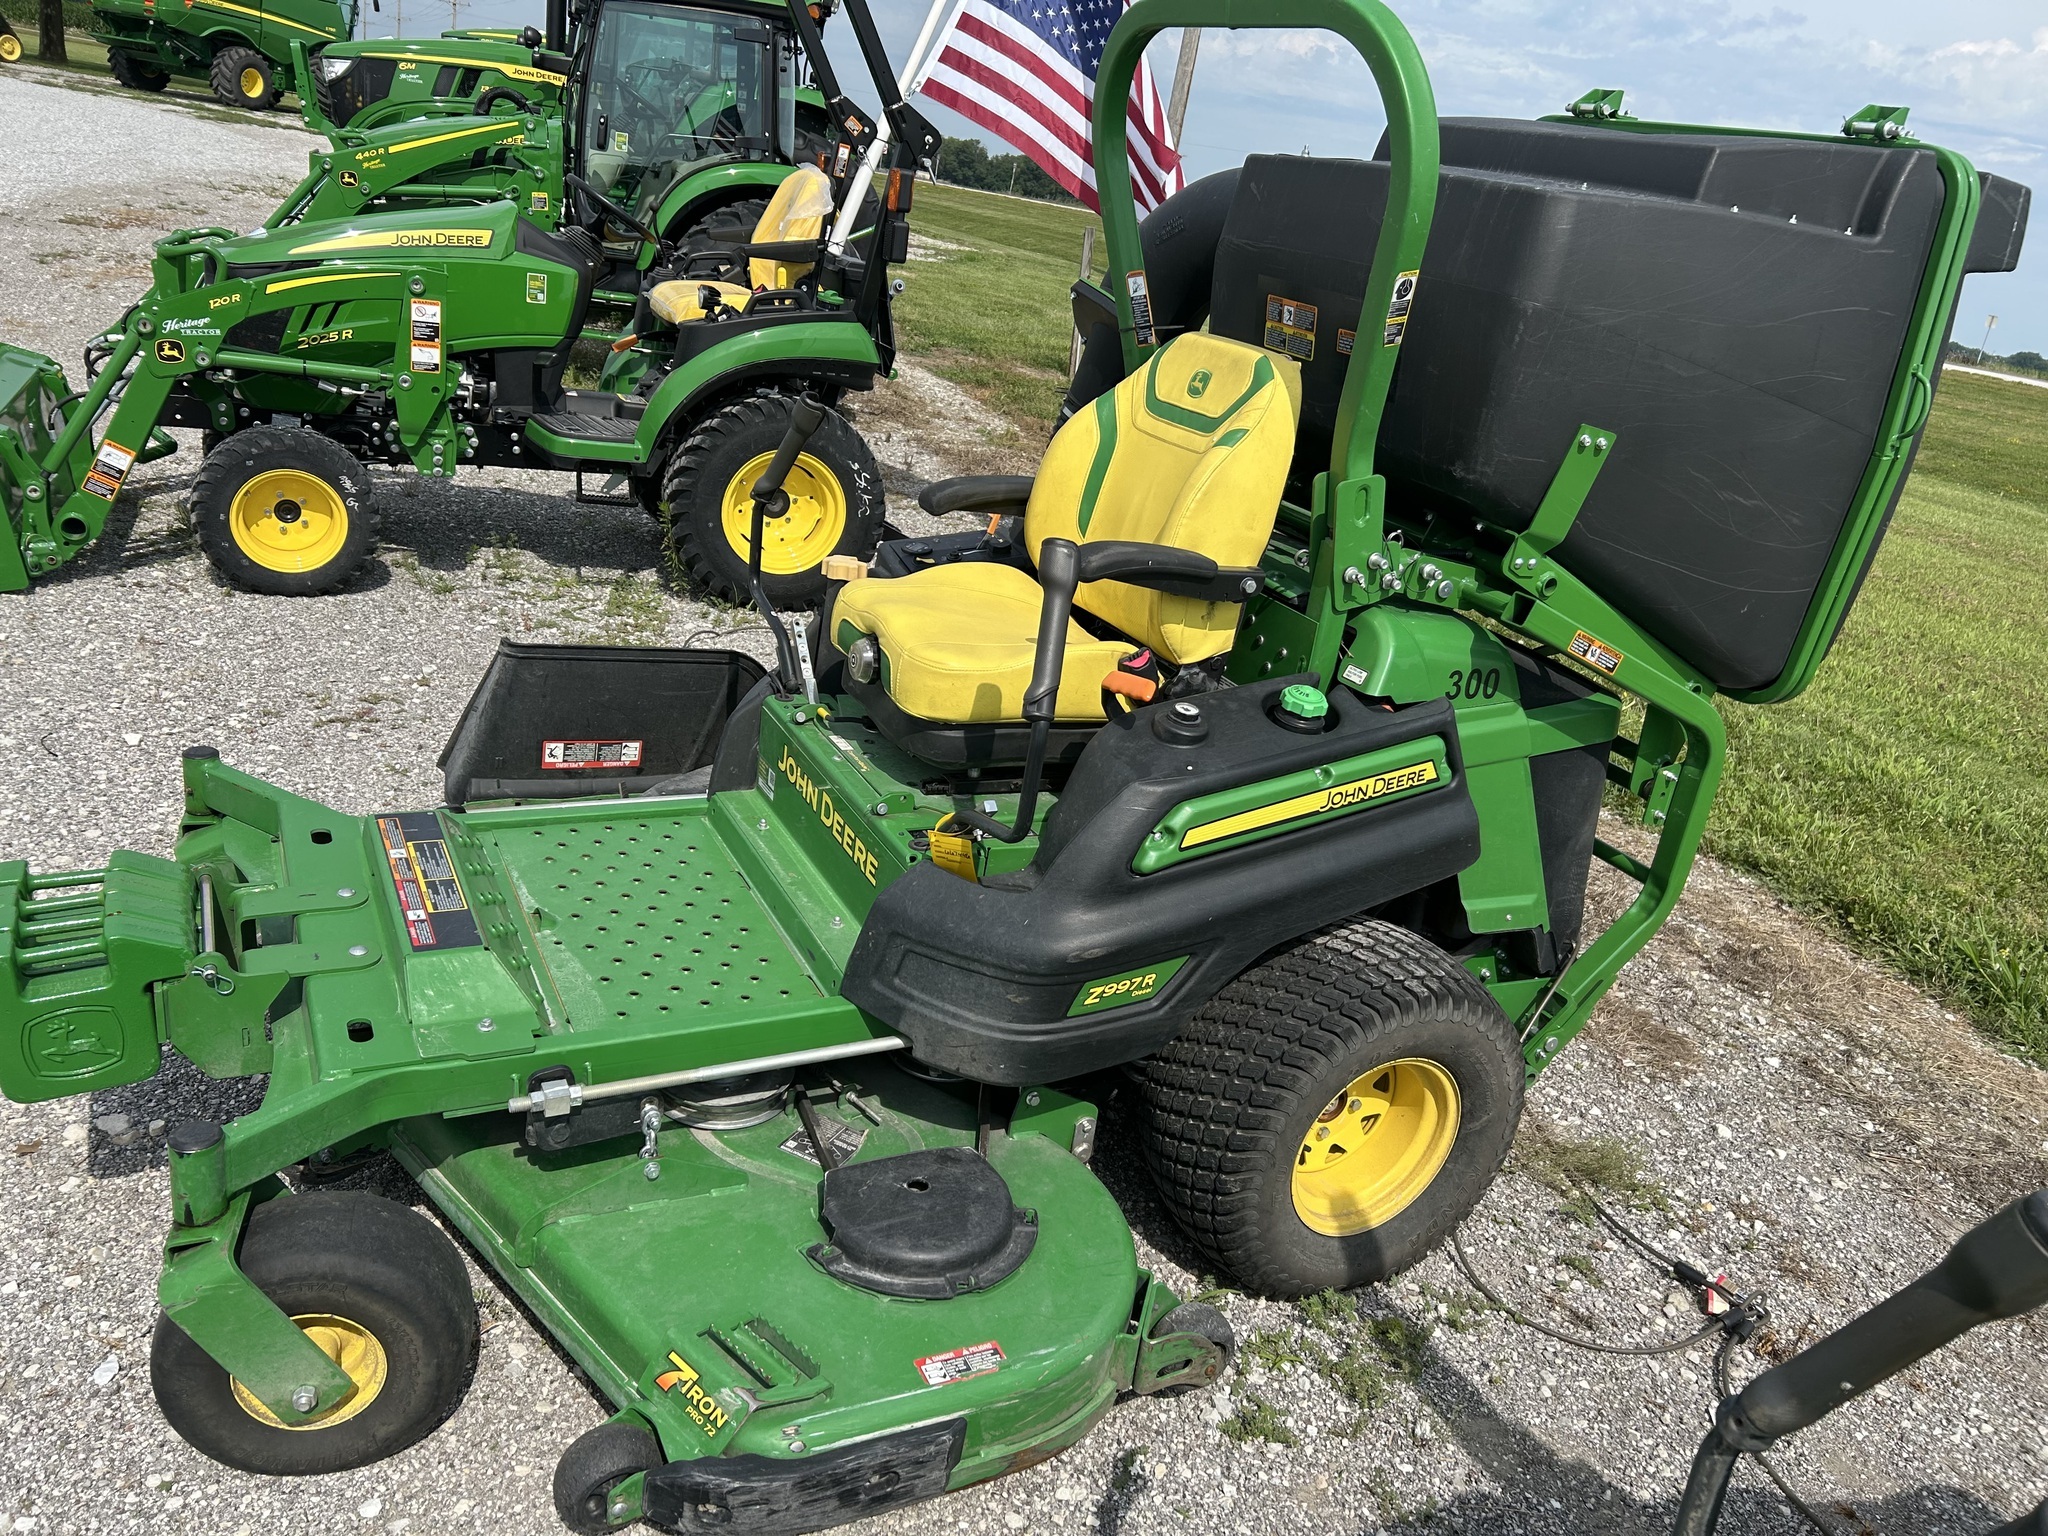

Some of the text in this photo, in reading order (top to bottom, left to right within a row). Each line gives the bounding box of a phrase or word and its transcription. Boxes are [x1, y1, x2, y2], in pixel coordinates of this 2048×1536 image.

[398, 62, 416, 70] 6M
[512, 68, 563, 82] JOHN DEERE
[391, 233, 484, 245] JOHN DEERE
[209, 294, 230, 309] 120
[162, 316, 211, 334] Heritage
[297, 331, 339, 350] 2025
[1445, 668, 1500, 700] 300
[1320, 768, 1427, 809] JOHN DEERE
[777, 744, 819, 813] JOHN
[820, 791, 879, 887] DEERE
[1083, 973, 1157, 1005] Z997R
[1131, 987, 1153, 997] Diesel
[931, 1351, 956, 1363] DANGER
[968, 1342, 993, 1354] PELIGRO
[685, 1405, 716, 1437] PRO 72
